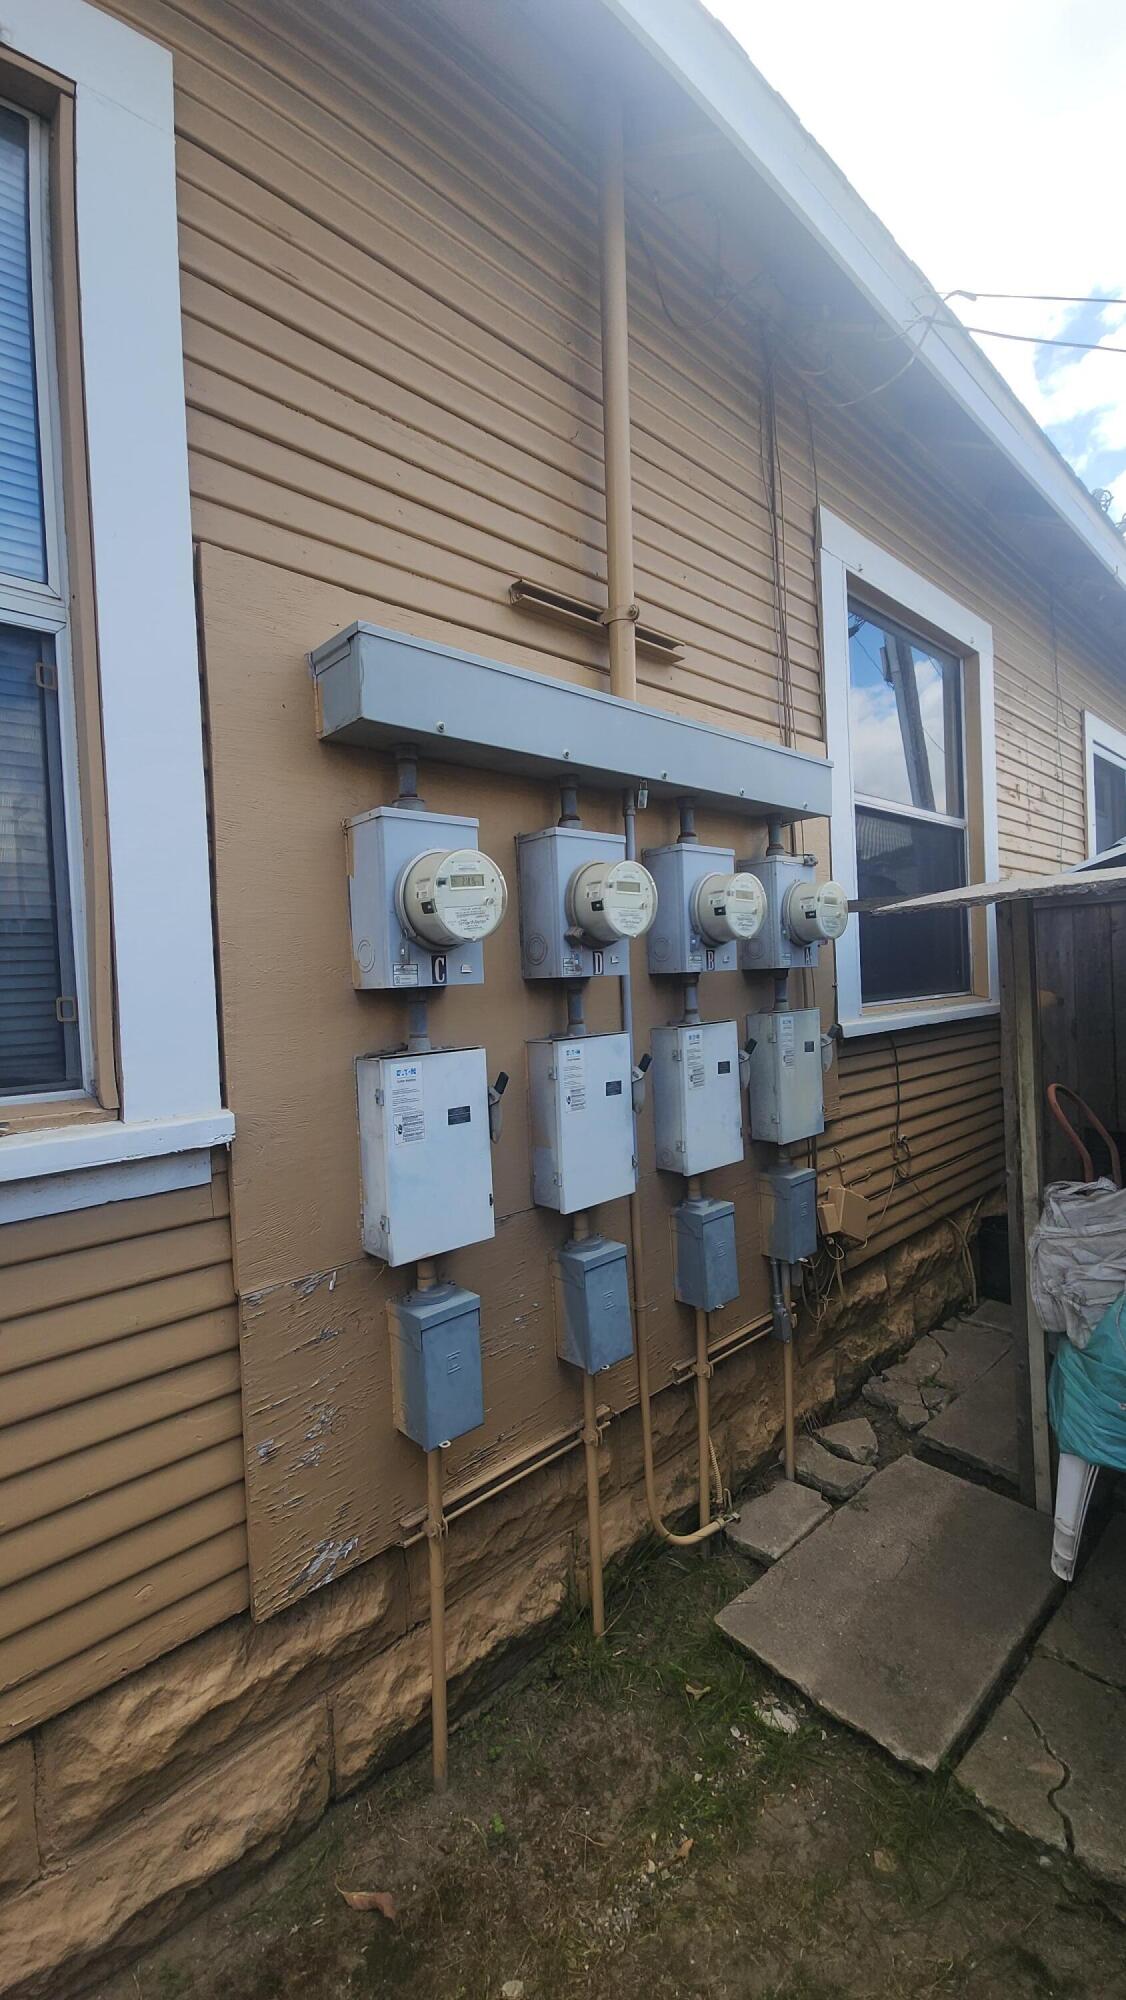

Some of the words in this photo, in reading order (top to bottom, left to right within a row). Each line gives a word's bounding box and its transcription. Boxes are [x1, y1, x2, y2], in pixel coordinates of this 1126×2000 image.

[434, 957, 445, 983] C
[595, 952, 602, 974] D
[708, 951, 715, 970] B
